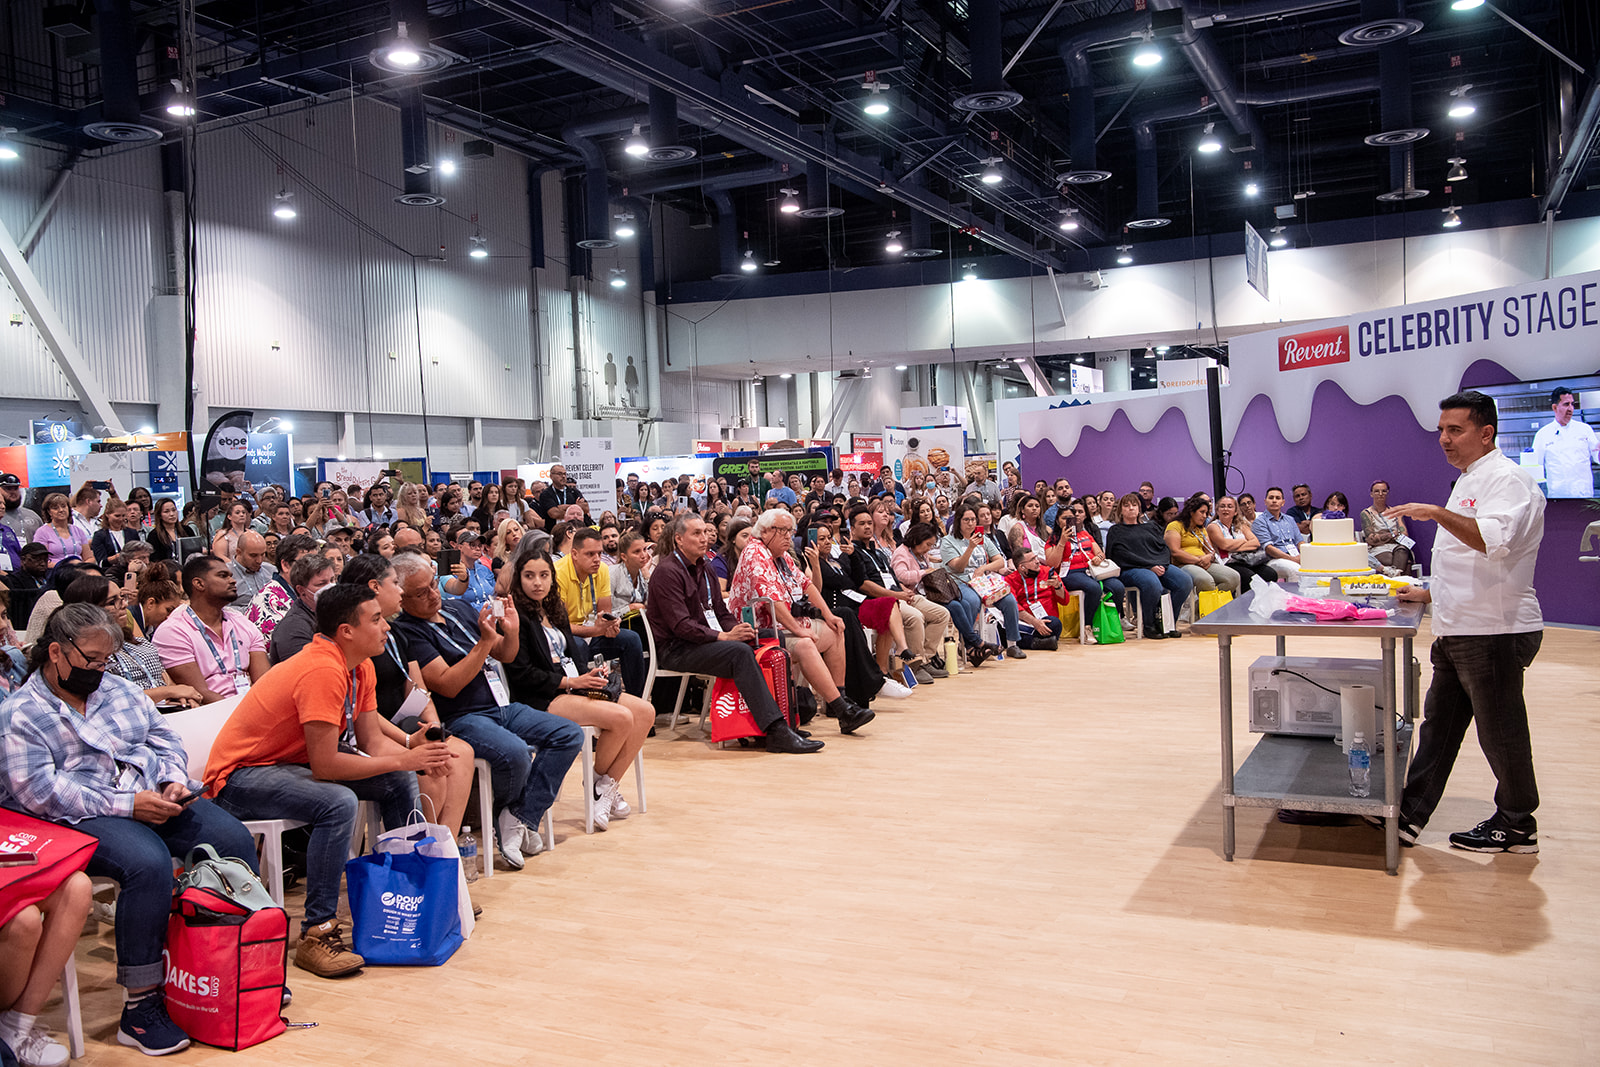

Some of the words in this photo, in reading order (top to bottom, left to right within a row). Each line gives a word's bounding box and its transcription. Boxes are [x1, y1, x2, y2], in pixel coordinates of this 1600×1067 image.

[1358, 300, 1495, 357] CELEBRITY
[1503, 282, 1598, 337] STAGE
[1283, 335, 1342, 366] Revent
[218, 436, 247, 447] ebpe
[568, 441, 581, 449] IBIE
[260, 456, 272, 465] Paris
[565, 464, 581, 472] REVENT
[582, 463, 604, 471] CELEBRITY
[335, 471, 353, 482] Bread
[579, 472, 592, 480] STAGE
[395, 893, 425, 904] DOUG
